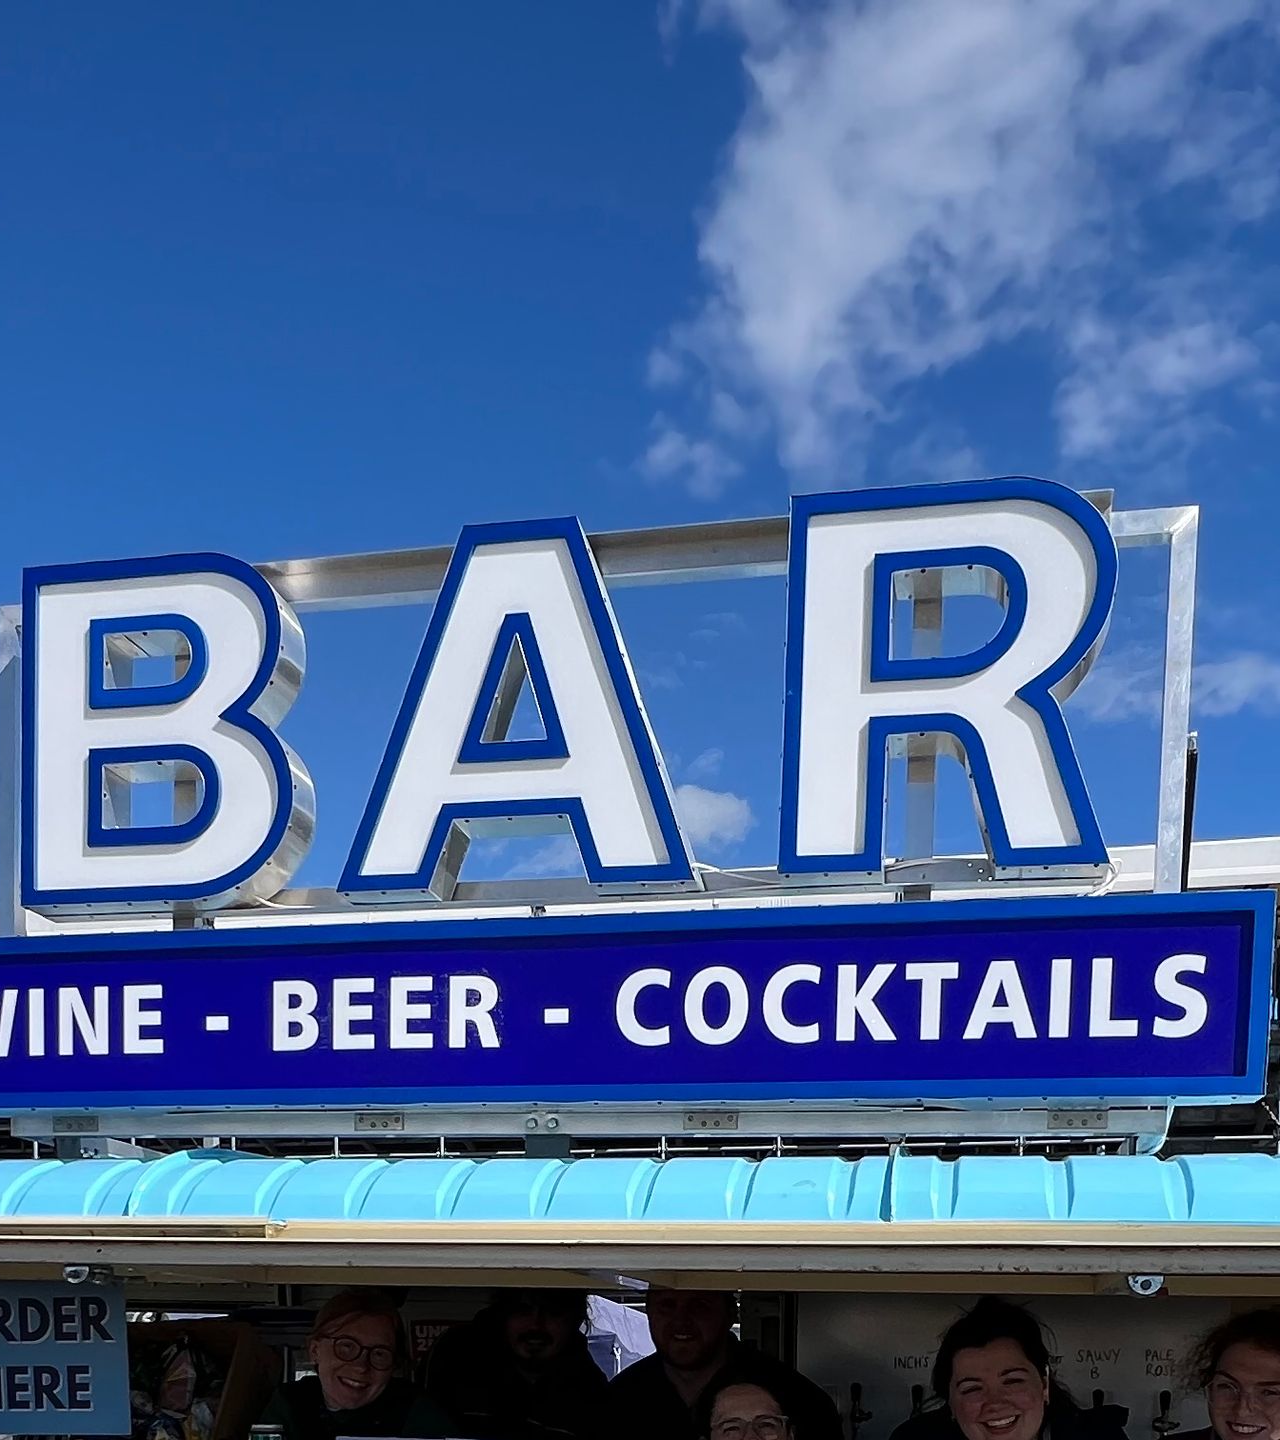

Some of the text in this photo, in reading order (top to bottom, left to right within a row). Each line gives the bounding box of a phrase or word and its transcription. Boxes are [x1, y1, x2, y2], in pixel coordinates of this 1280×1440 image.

[20, 475, 1119, 909] BAR
[271, 975, 500, 1053] BEER
[614, 953, 1210, 1046] COCKTAILS
[1075, 1349, 1121, 1364] SAUVY
[1145, 1349, 1175, 1361] PALE
[1090, 1366, 1100, 1379] B
